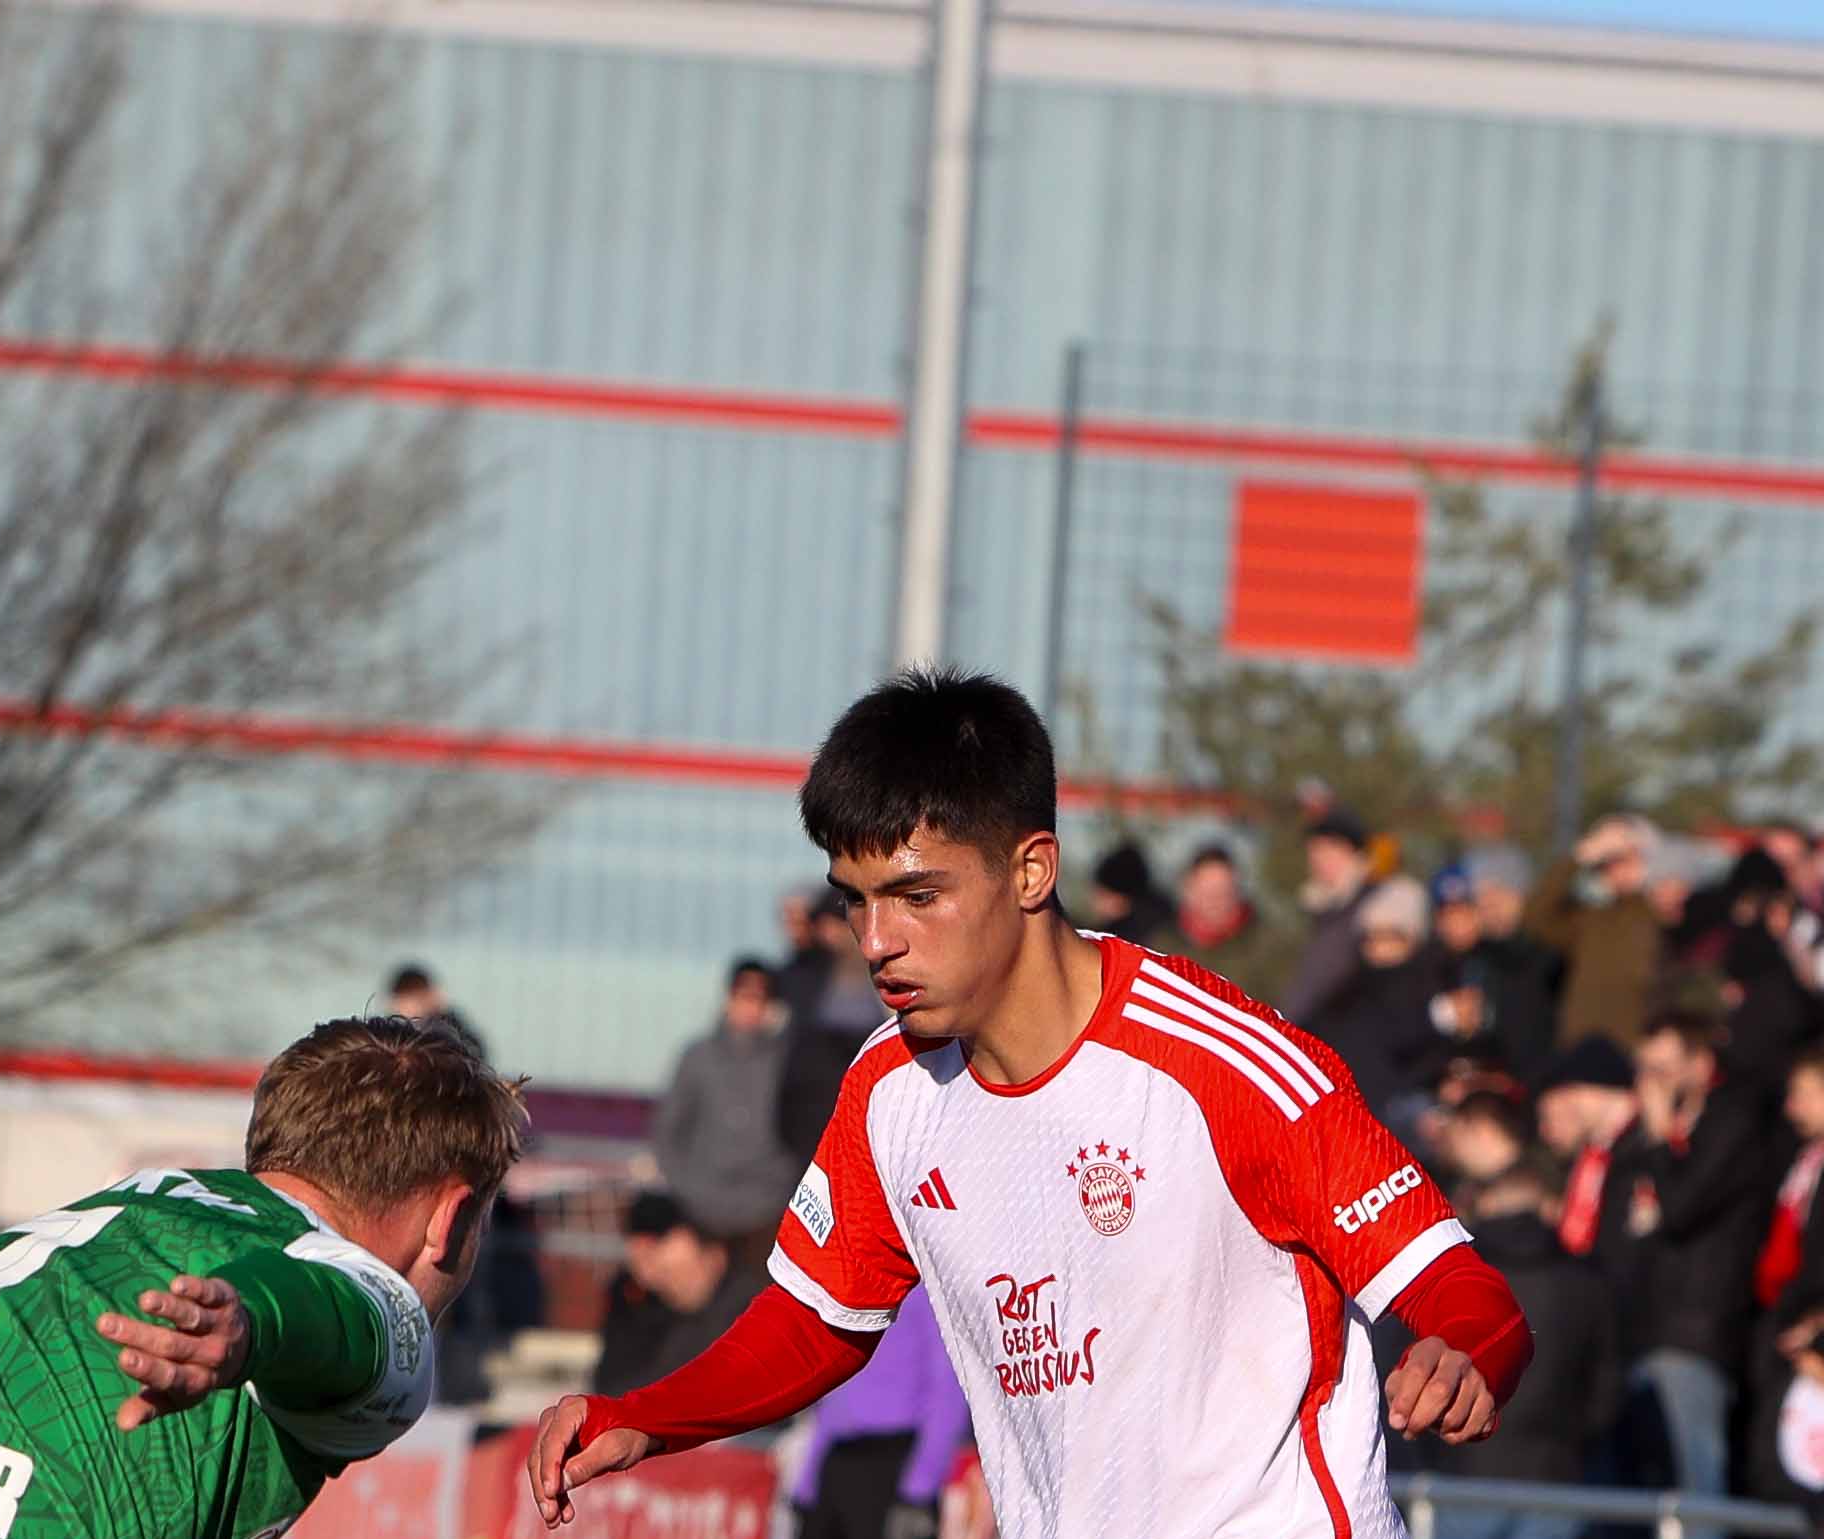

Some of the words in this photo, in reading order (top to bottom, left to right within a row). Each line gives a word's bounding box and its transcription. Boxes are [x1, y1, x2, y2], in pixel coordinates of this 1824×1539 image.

[1333, 1164, 1423, 1234] tipico
[985, 1273, 1057, 1326] ROT
[1002, 1301, 1059, 1357] GEGEN
